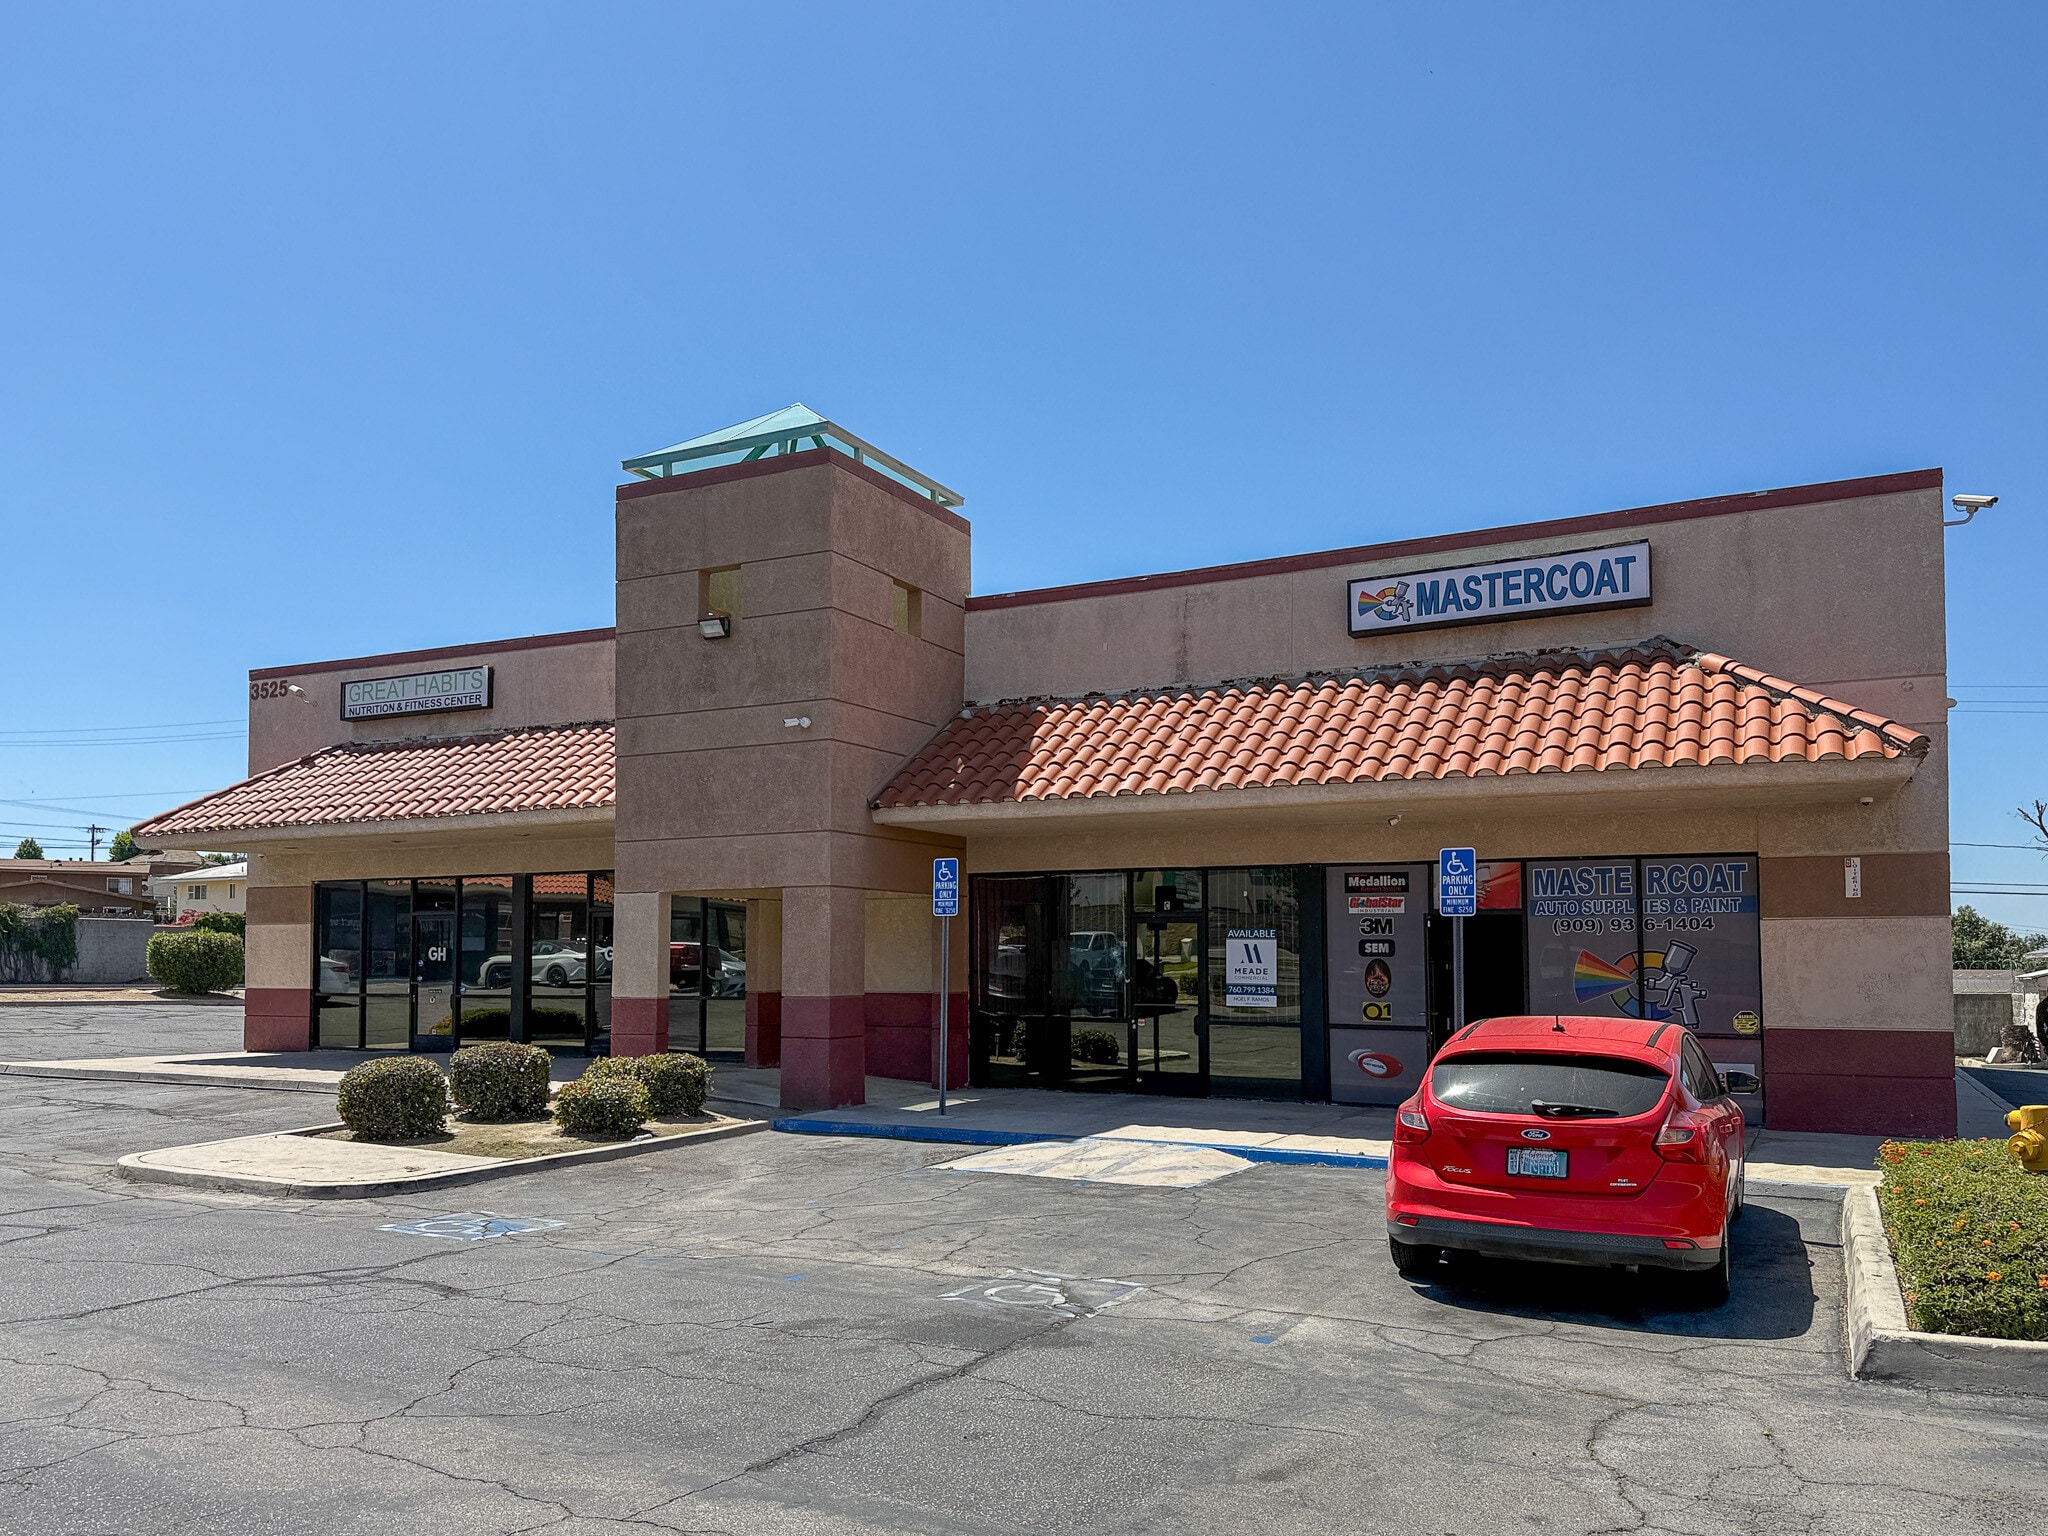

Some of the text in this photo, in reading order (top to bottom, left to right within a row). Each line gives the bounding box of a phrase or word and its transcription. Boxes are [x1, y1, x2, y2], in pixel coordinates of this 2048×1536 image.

[1416, 555, 1637, 617] MASTERCOAT
[250, 680, 289, 700] 3525
[349, 670, 484, 702] GREAT HABITS
[348, 694, 482, 716] NUTRITION & FITNESS CENTER
[935, 881, 957, 890] PARKING
[1348, 875, 1406, 887] Medallion
[1442, 875, 1474, 885] PARKING
[939, 890, 953, 899] ONLY
[1448, 885, 1468, 896] ONLY
[1442, 906, 1455, 914] FINE
[1535, 900, 1579, 915] AUTO
[1673, 898, 1687, 913] &
[1691, 897, 1741, 913] PAINT
[1359, 917, 1395, 936] 3M
[1552, 918, 1604, 936] (909)
[1227, 929, 1276, 938] AVAILABLE
[1364, 943, 1389, 953] SEM
[428, 946, 447, 962] GH
[1234, 967, 1269, 975] MEADE
[1228, 986, 1275, 994] 760.799.1384
